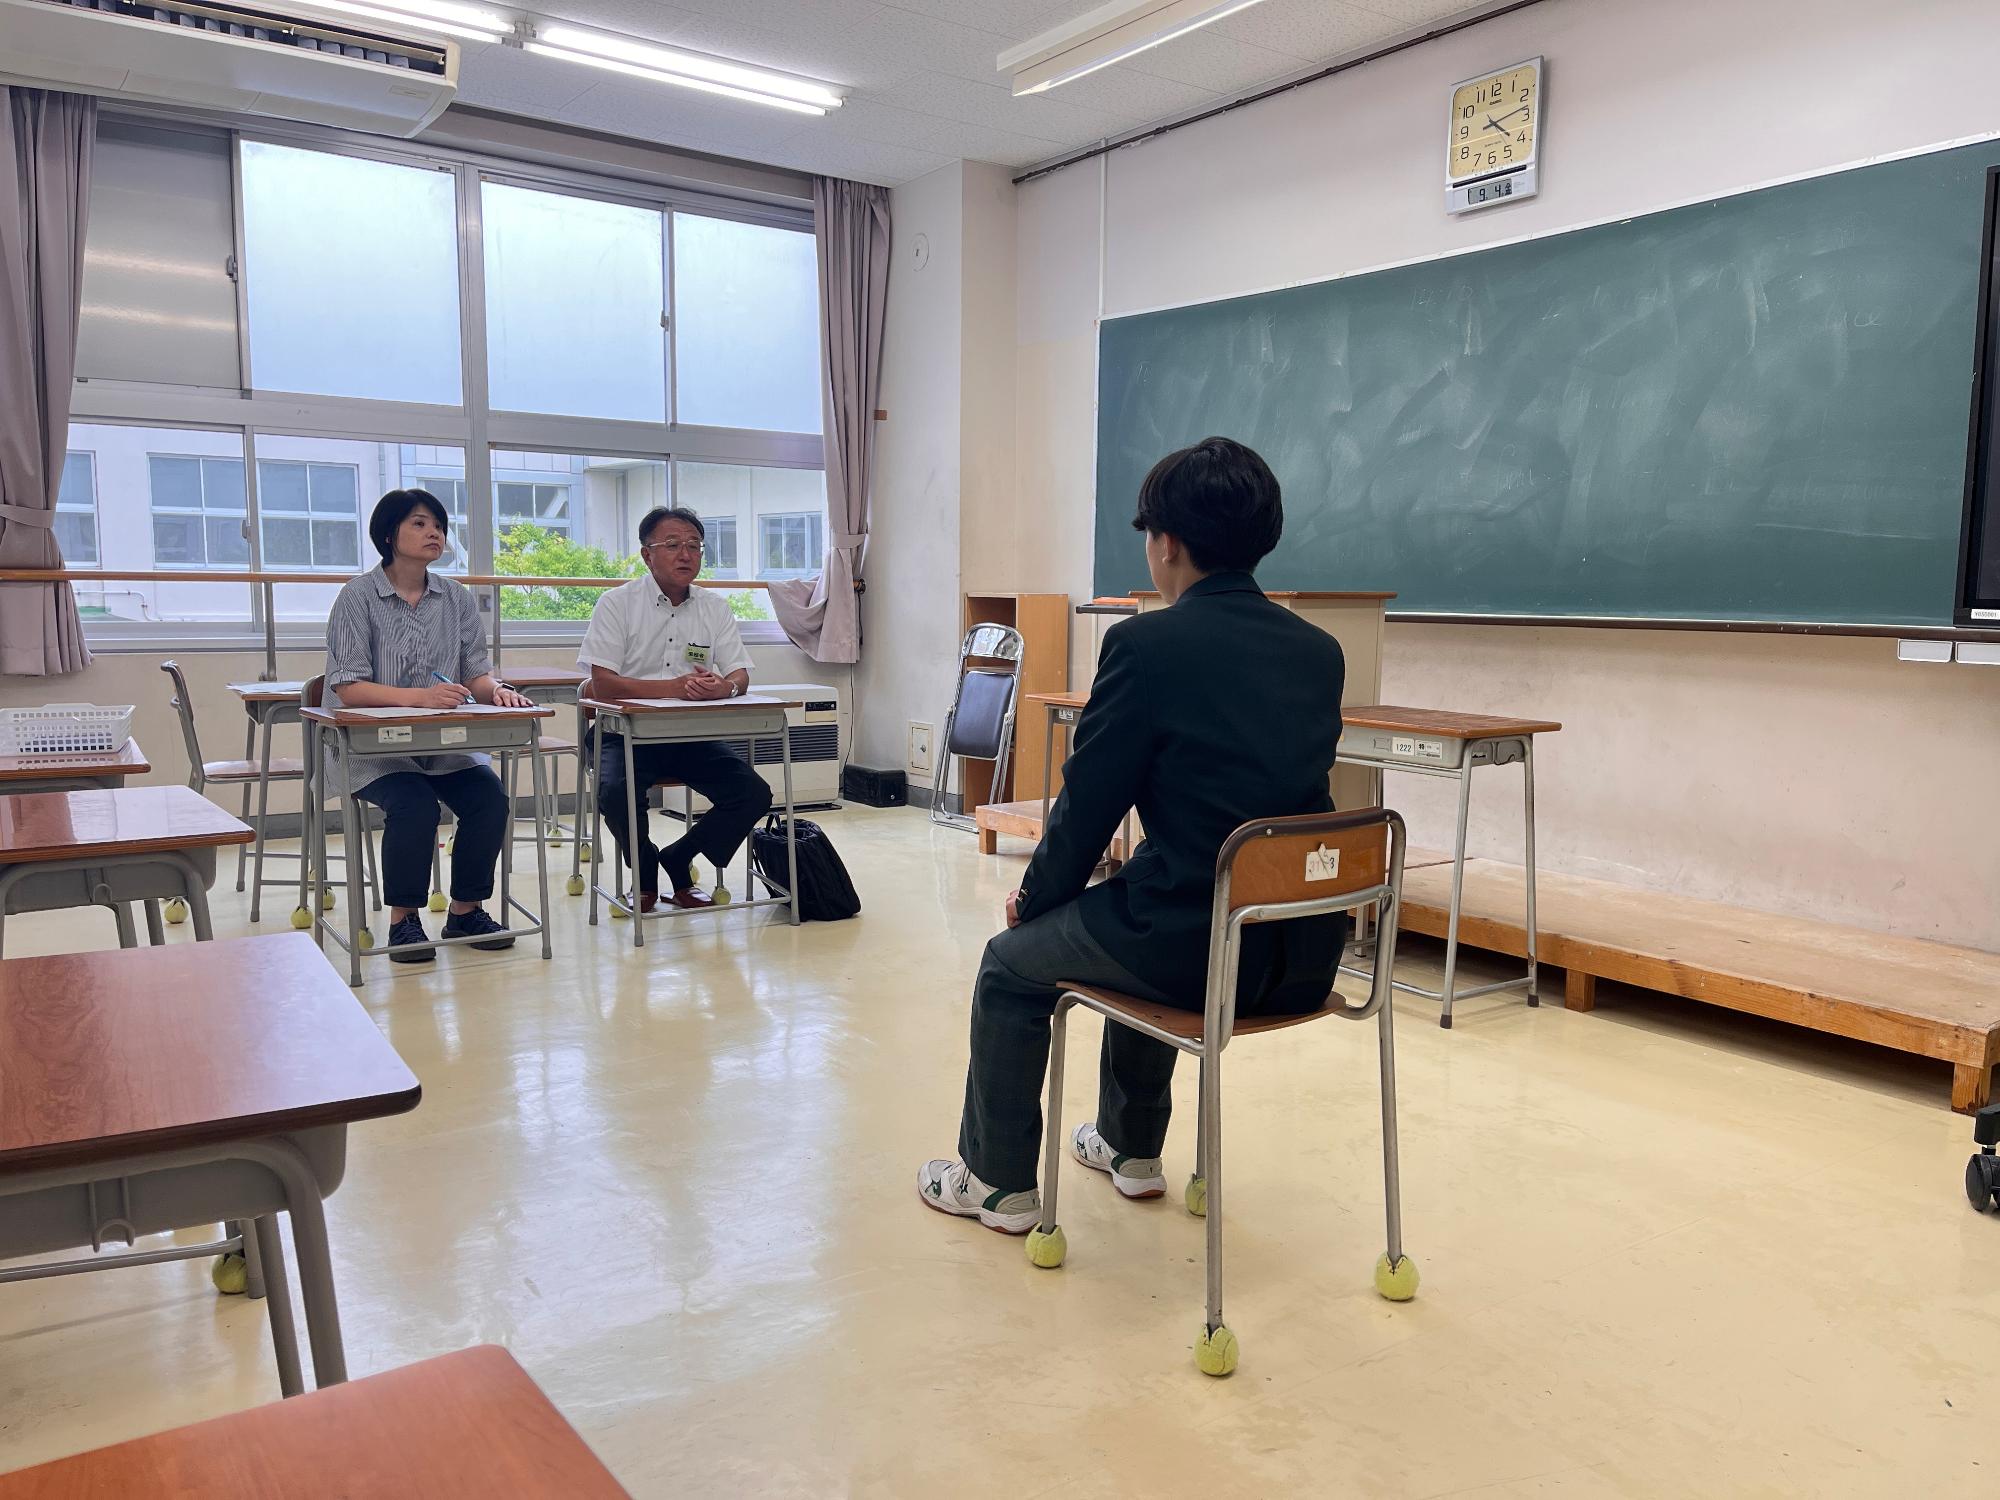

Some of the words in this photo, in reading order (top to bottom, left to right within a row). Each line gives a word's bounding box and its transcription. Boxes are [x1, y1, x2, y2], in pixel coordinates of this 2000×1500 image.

[1476, 89, 1486, 103] 11
[1491, 82, 1502, 97] 12
[1520, 88, 1529, 102] 2
[1463, 105, 1475, 119] 10
[1521, 107, 1530, 121] 3
[1460, 125, 1469, 139] 9
[1517, 130, 1526, 143] 4
[1461, 146, 1470, 160] 8
[1488, 150, 1497, 164] 6
[1503, 144, 1512, 159] 5
[1473, 153, 1482, 167] 7
[1396, 743, 1412, 752] 1222
